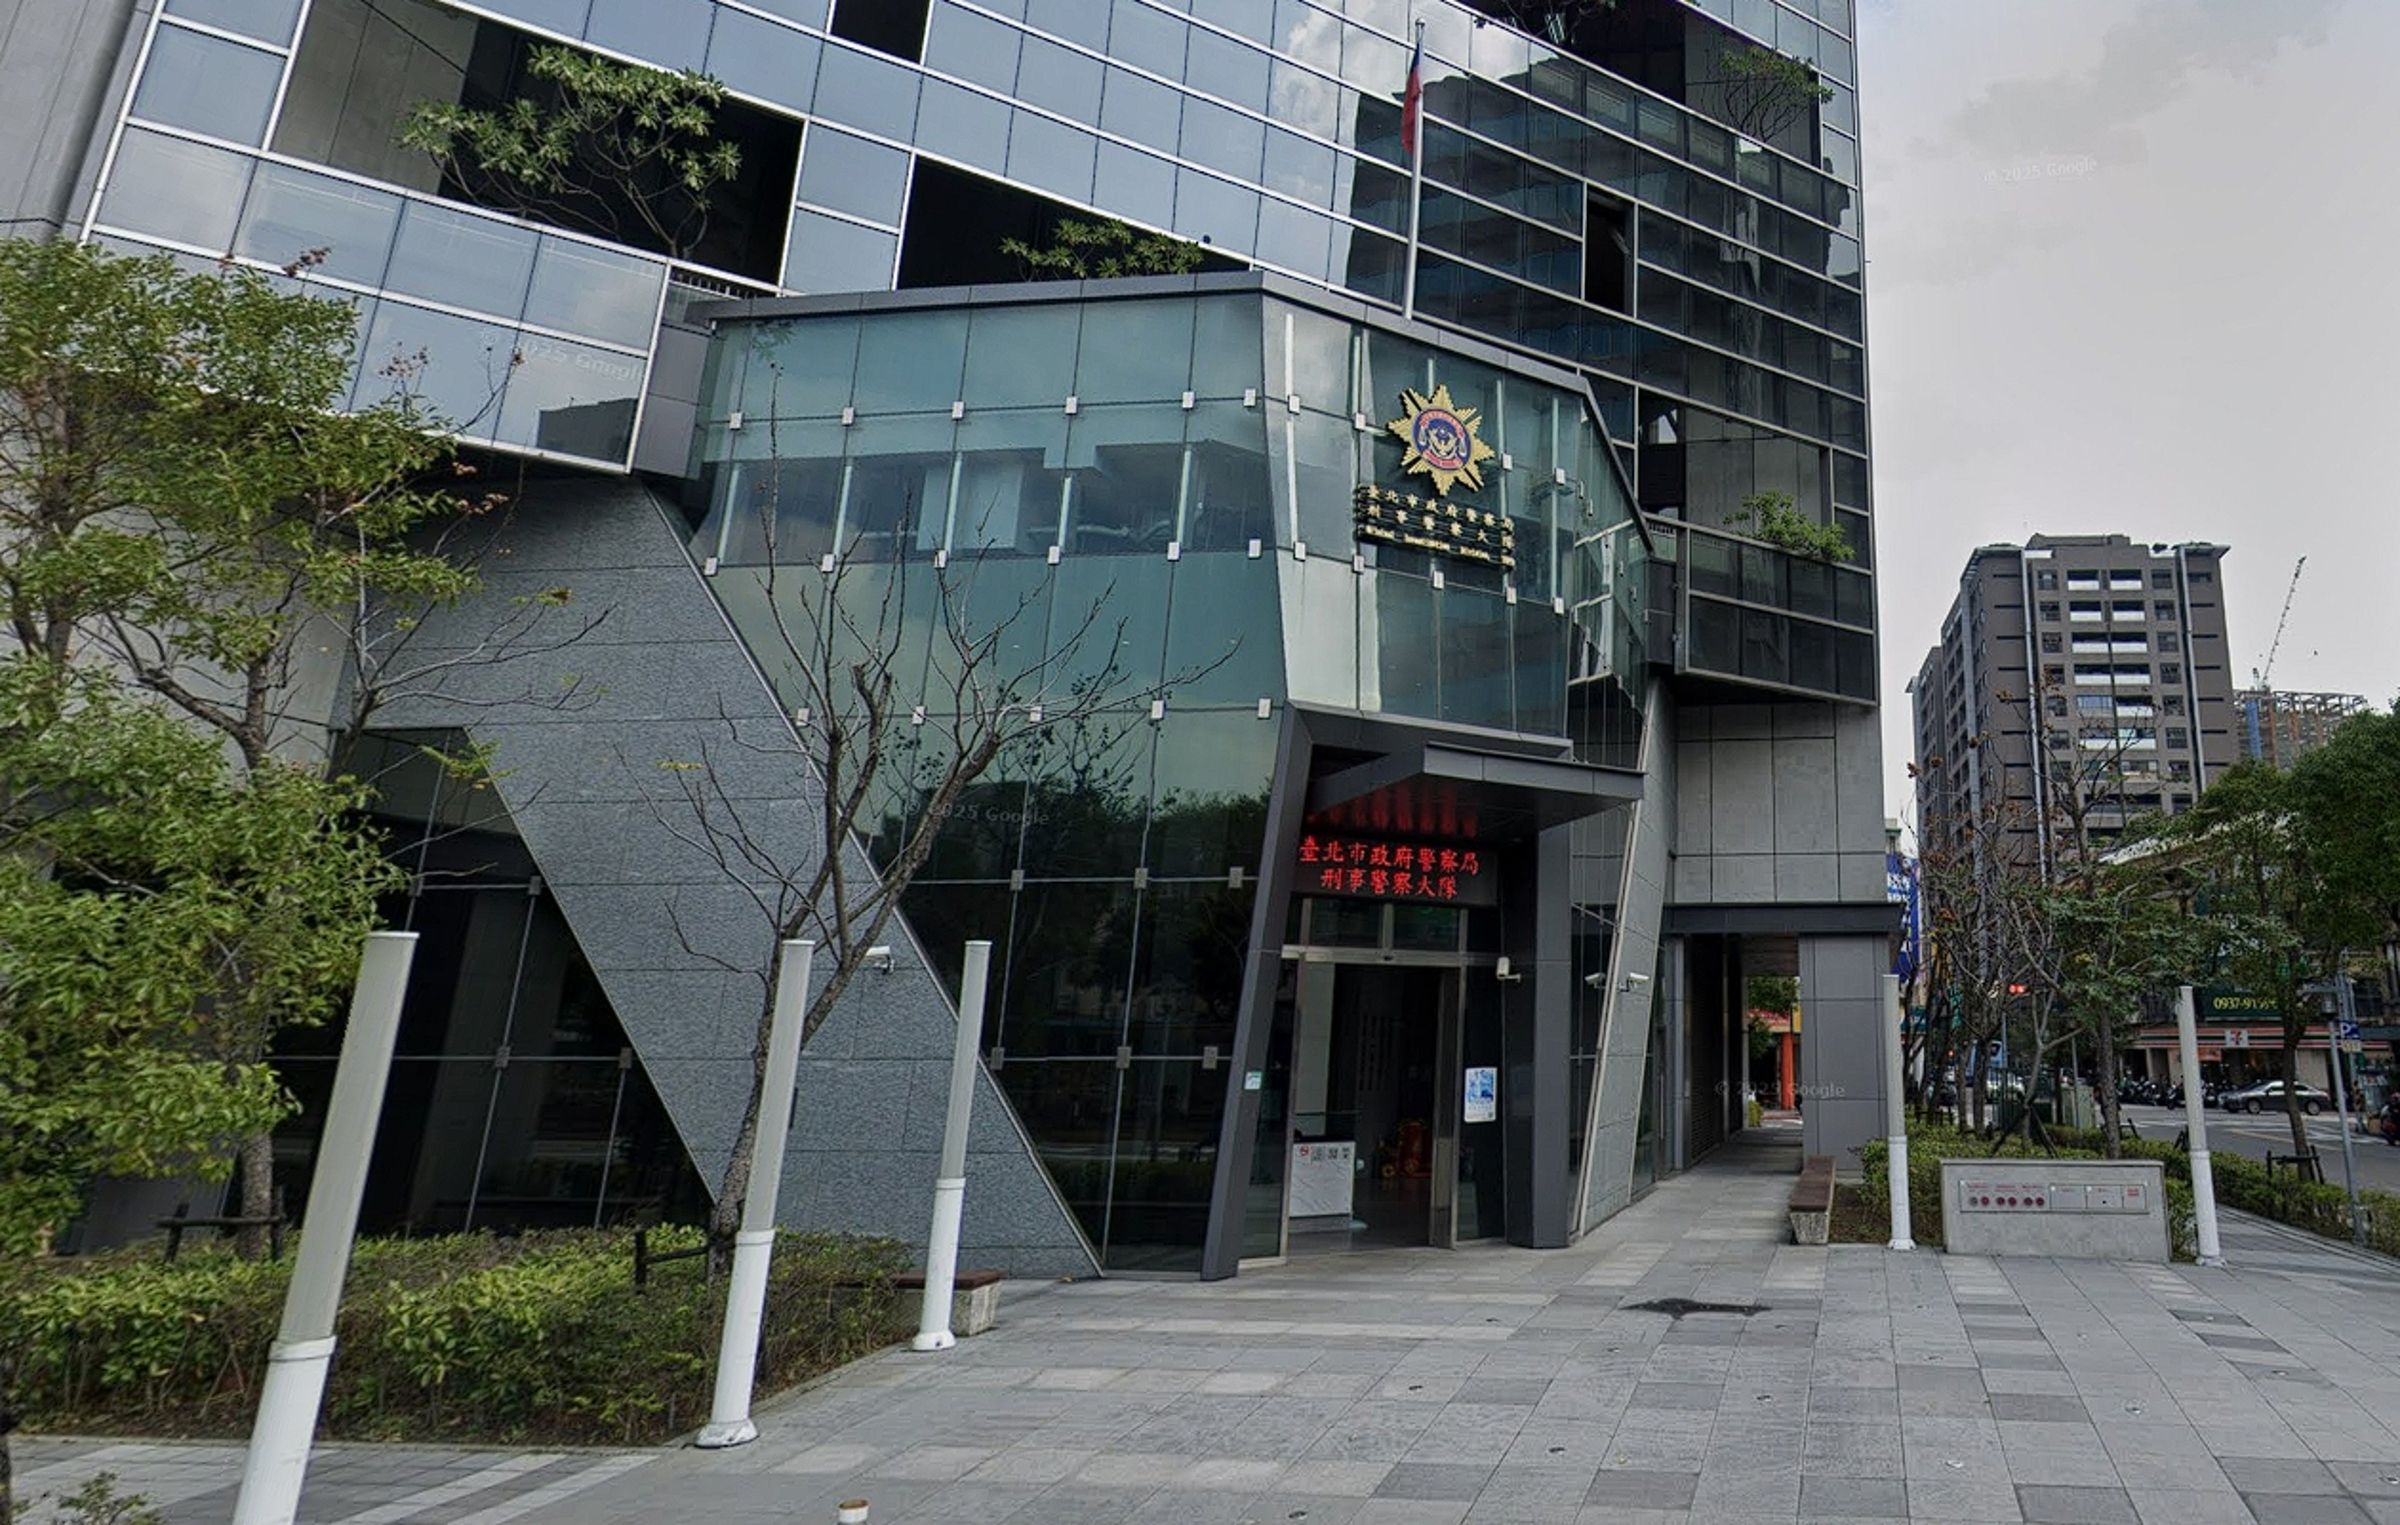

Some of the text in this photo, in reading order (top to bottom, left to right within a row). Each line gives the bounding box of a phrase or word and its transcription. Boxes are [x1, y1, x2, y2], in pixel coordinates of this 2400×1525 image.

[1300, 836, 1479, 876] 臺北市政府警察局
[1320, 868, 1457, 899] 刑事警察大隊
